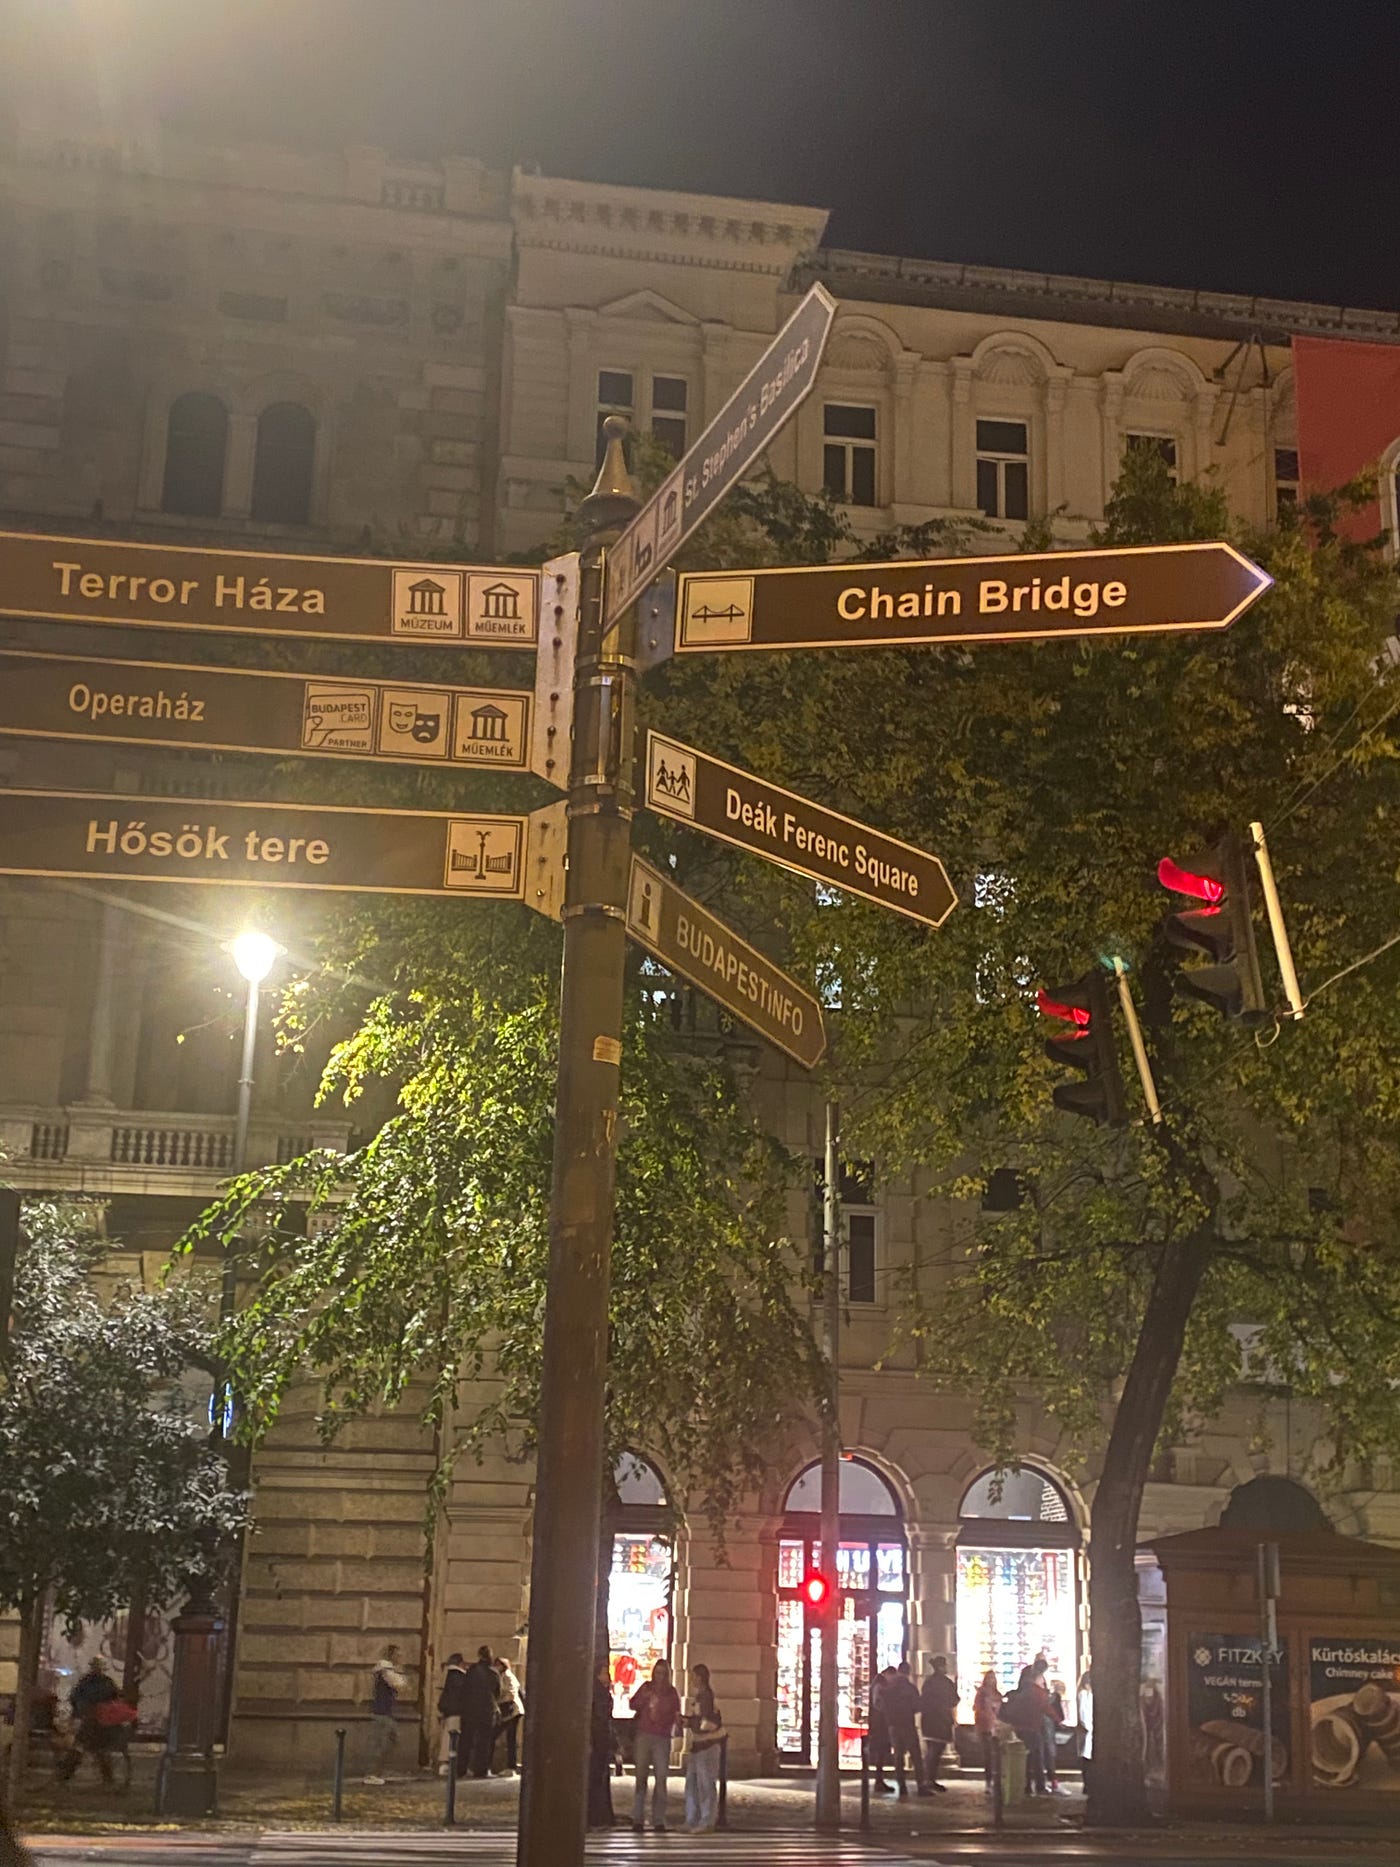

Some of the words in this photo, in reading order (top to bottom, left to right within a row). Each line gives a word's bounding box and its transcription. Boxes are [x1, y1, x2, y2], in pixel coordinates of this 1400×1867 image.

[702, 403, 758, 489] Stephen's
[760, 336, 809, 417] Basilica
[52, 561, 200, 605] Terror
[215, 576, 326, 615] Háza
[837, 583, 962, 621] Chain
[978, 575, 1128, 617] Bridge
[400, 617, 454, 631] MÚZEUM
[474, 621, 527, 635] MŰEMLÉK
[68, 683, 206, 722] Operaház
[311, 702, 367, 714] BUDAPEST
[340, 713, 368, 724] CARD
[327, 737, 368, 749] PARTNER
[461, 742, 514, 758] MŰEMLÉK
[86, 820, 231, 860] Hősök
[245, 830, 331, 866] tere
[726, 788, 777, 838] Deák
[783, 812, 850, 868] Ferenc
[854, 844, 919, 897] Square
[1312, 1647, 1400, 1665] Kürtőskalác
[1325, 1667, 1368, 1681] Chimney
[1370, 1669, 1394, 1679] cake
